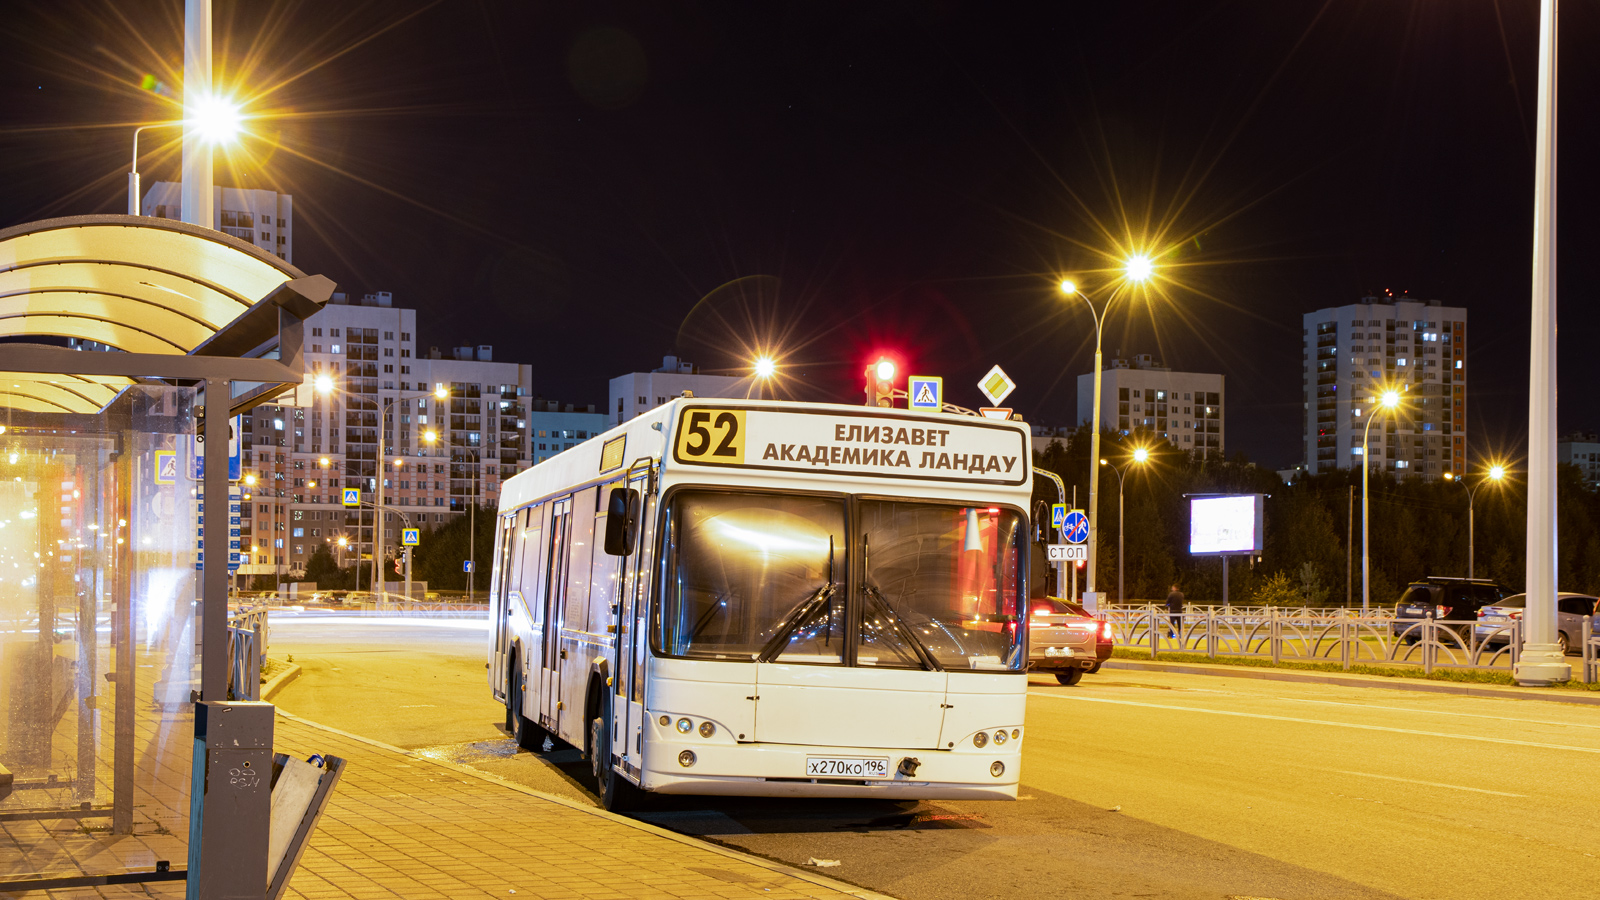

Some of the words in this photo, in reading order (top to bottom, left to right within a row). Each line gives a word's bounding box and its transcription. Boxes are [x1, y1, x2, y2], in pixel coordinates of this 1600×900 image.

[686, 411, 739, 457] 52
[834, 423, 950, 447] ЕЛИЗАВЕТ
[762, 443, 911, 468] АКАДЕМИКА
[918, 451, 1018, 475] ЛАНДАУ
[1050, 547, 1083, 558] СТОП
[864, 760, 884, 772] 196
